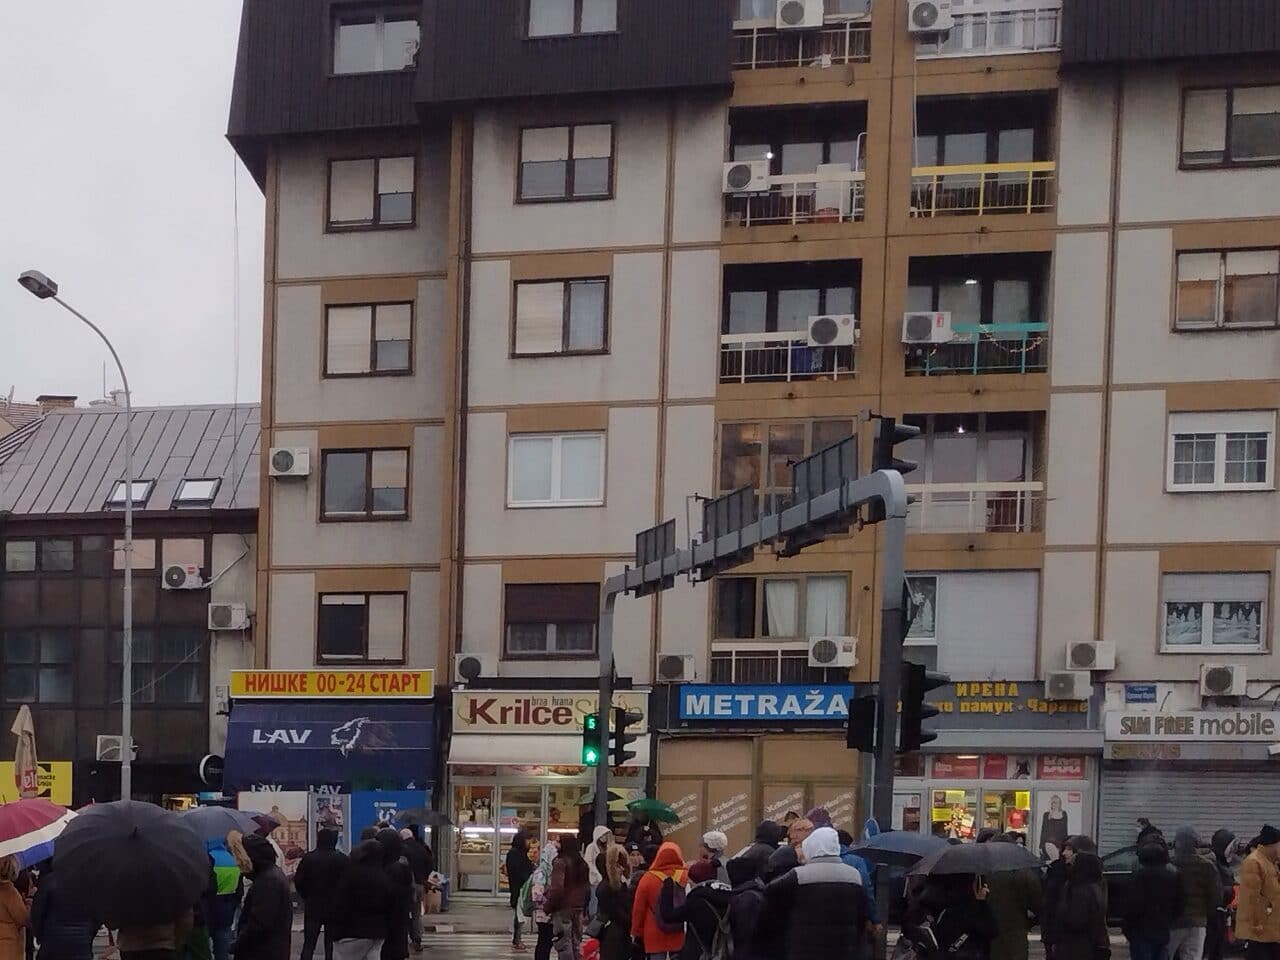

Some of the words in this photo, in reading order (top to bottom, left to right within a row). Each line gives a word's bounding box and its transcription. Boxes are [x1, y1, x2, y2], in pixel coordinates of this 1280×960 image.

[245, 673, 308, 692] НИШКЕ
[316, 673, 366, 693] 00-24
[370, 673, 421, 692] СТАРТ
[956, 682, 1019, 697] ИРЕНА
[531, 696, 548, 706] brza
[552, 696, 574, 706] hrana
[686, 689, 849, 715] METRAŽA
[960, 700, 1014, 715] памук
[469, 698, 573, 725] Krilce
[1120, 716, 1152, 735] SIM
[1154, 716, 1195, 735] FREE
[1200, 713, 1275, 735] mobile
[252, 729, 313, 744] LAV
